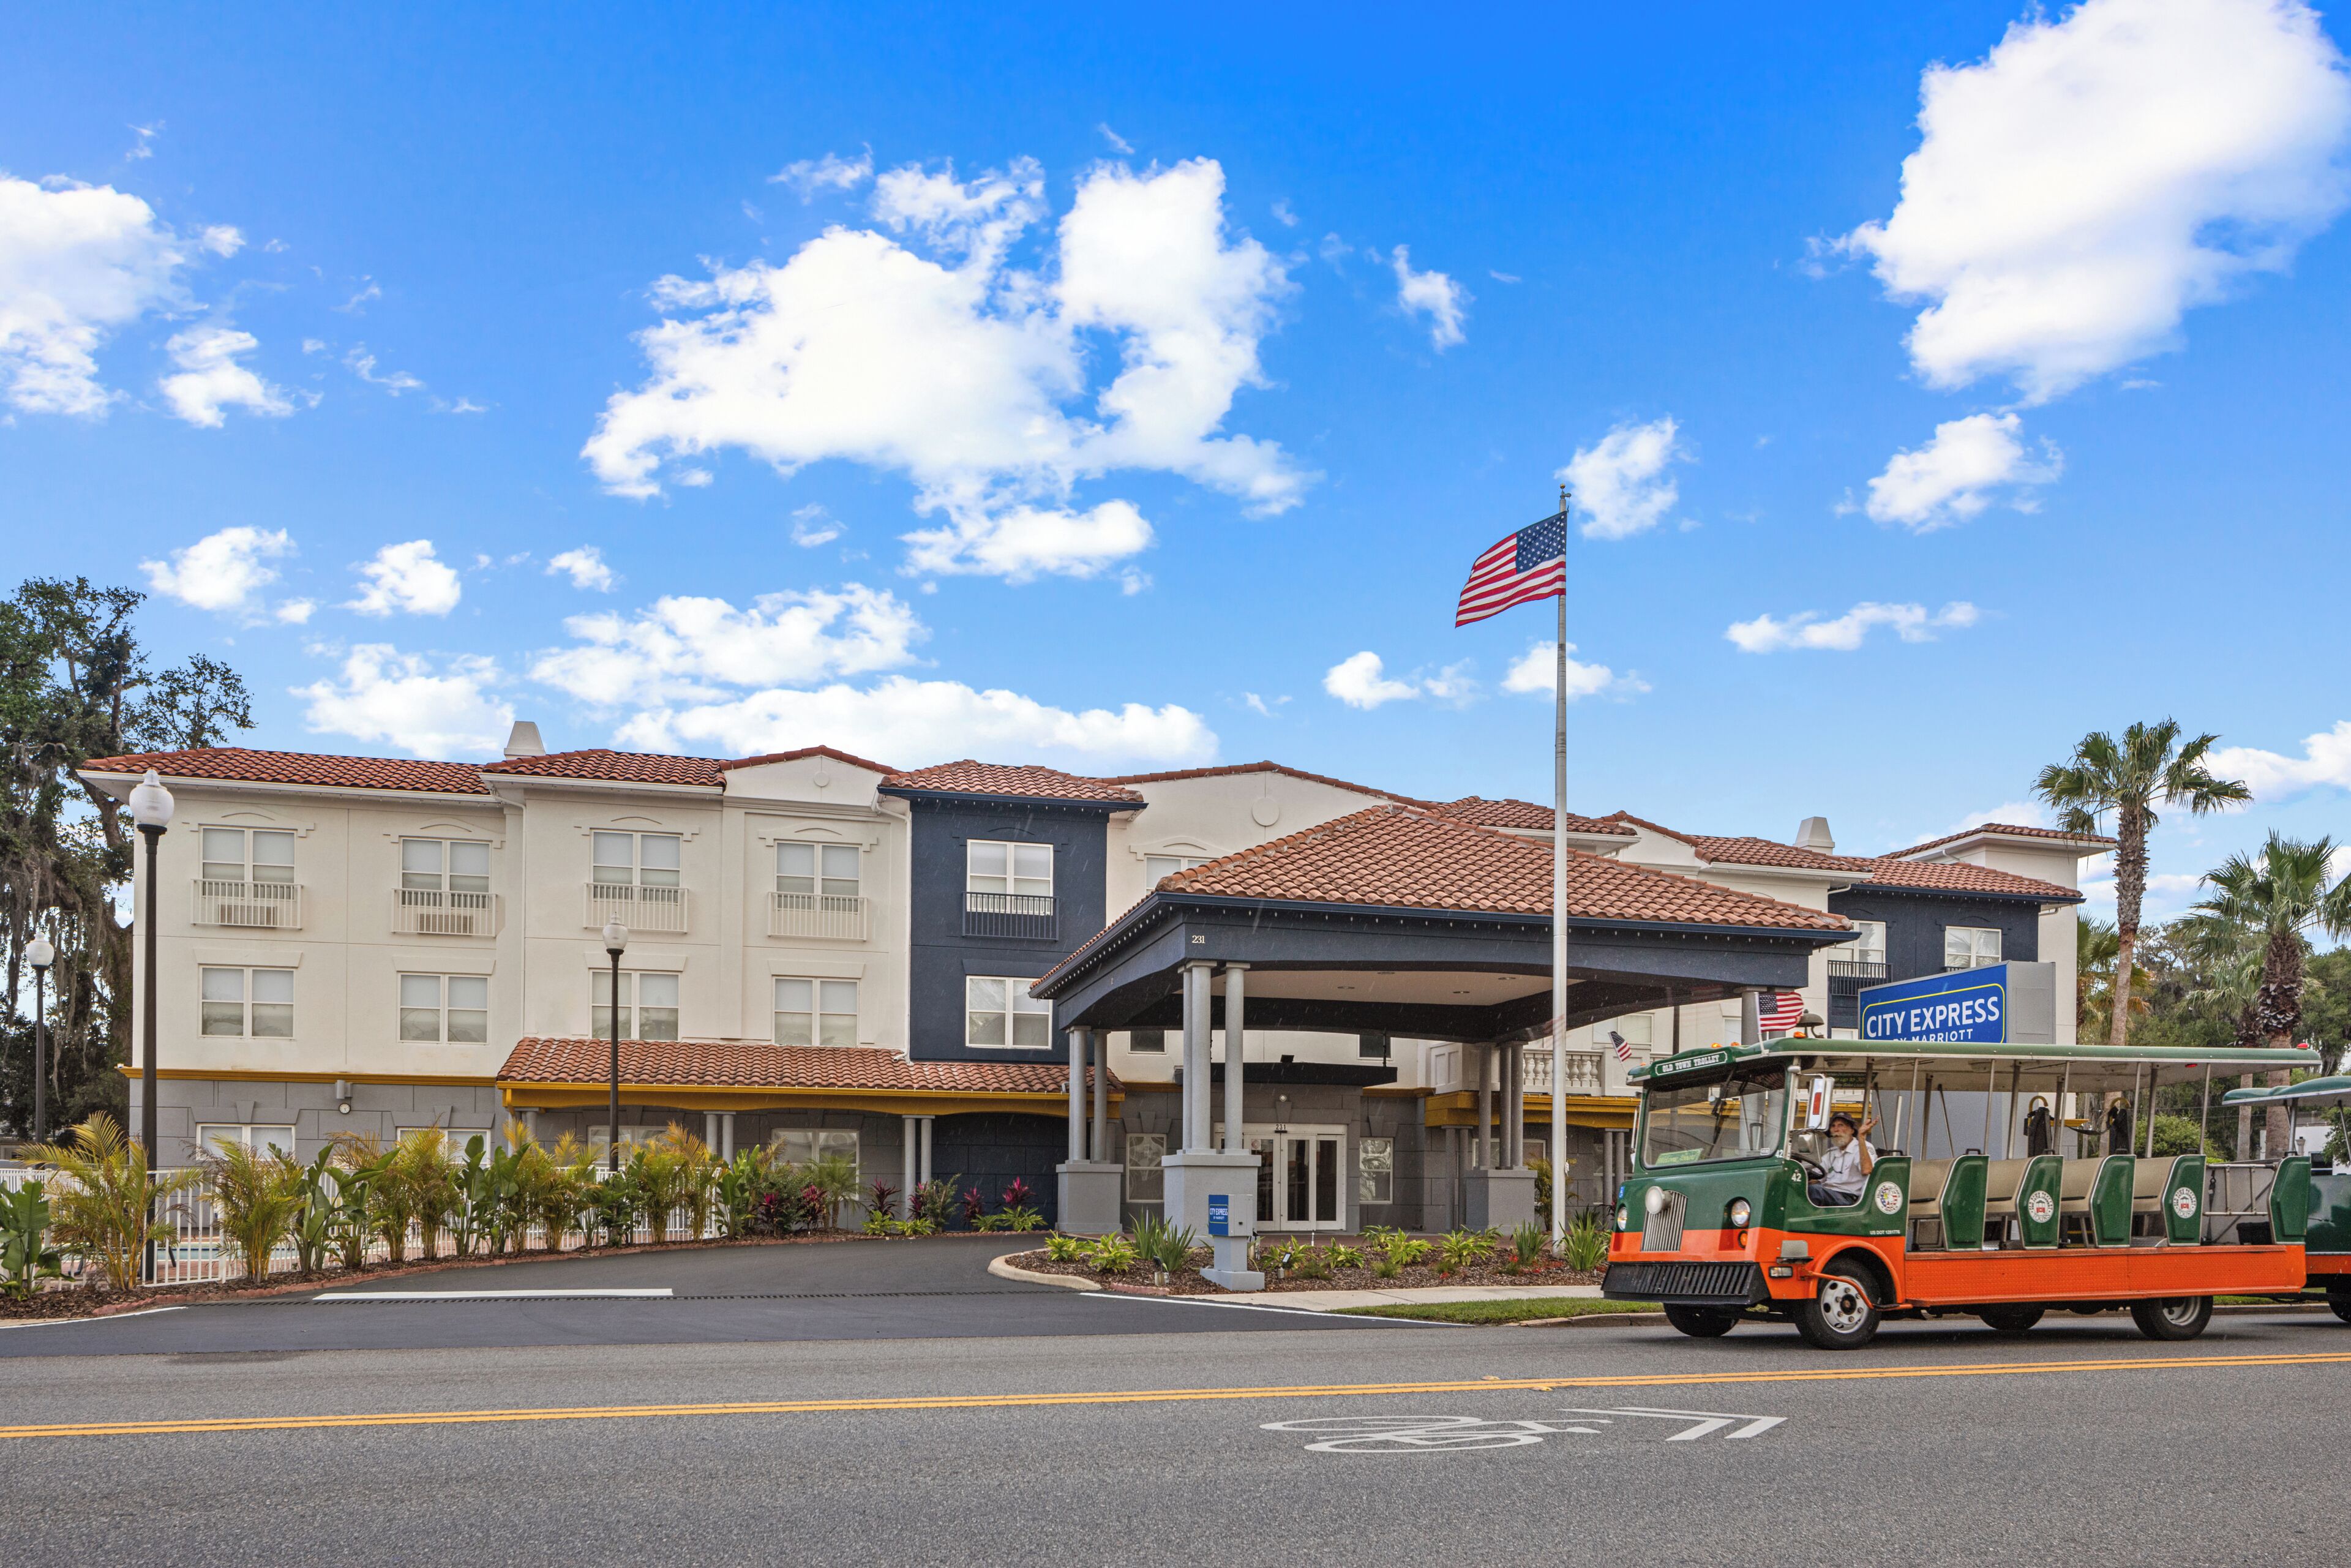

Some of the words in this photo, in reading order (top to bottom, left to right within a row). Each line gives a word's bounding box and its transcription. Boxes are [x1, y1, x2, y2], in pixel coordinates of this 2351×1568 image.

[1191, 935, 1205, 943] 231
[1867, 1011, 1906, 1038] CITY
[1910, 996, 2000, 1032] EXPRESS
[1662, 1063, 1673, 1073] OLD
[1674, 1060, 1692, 1070] TOWN
[1693, 1054, 1720, 1067] TROLLEY
[1775, 1149, 1783, 1158] 42
[1791, 1173, 1802, 1182] 42
